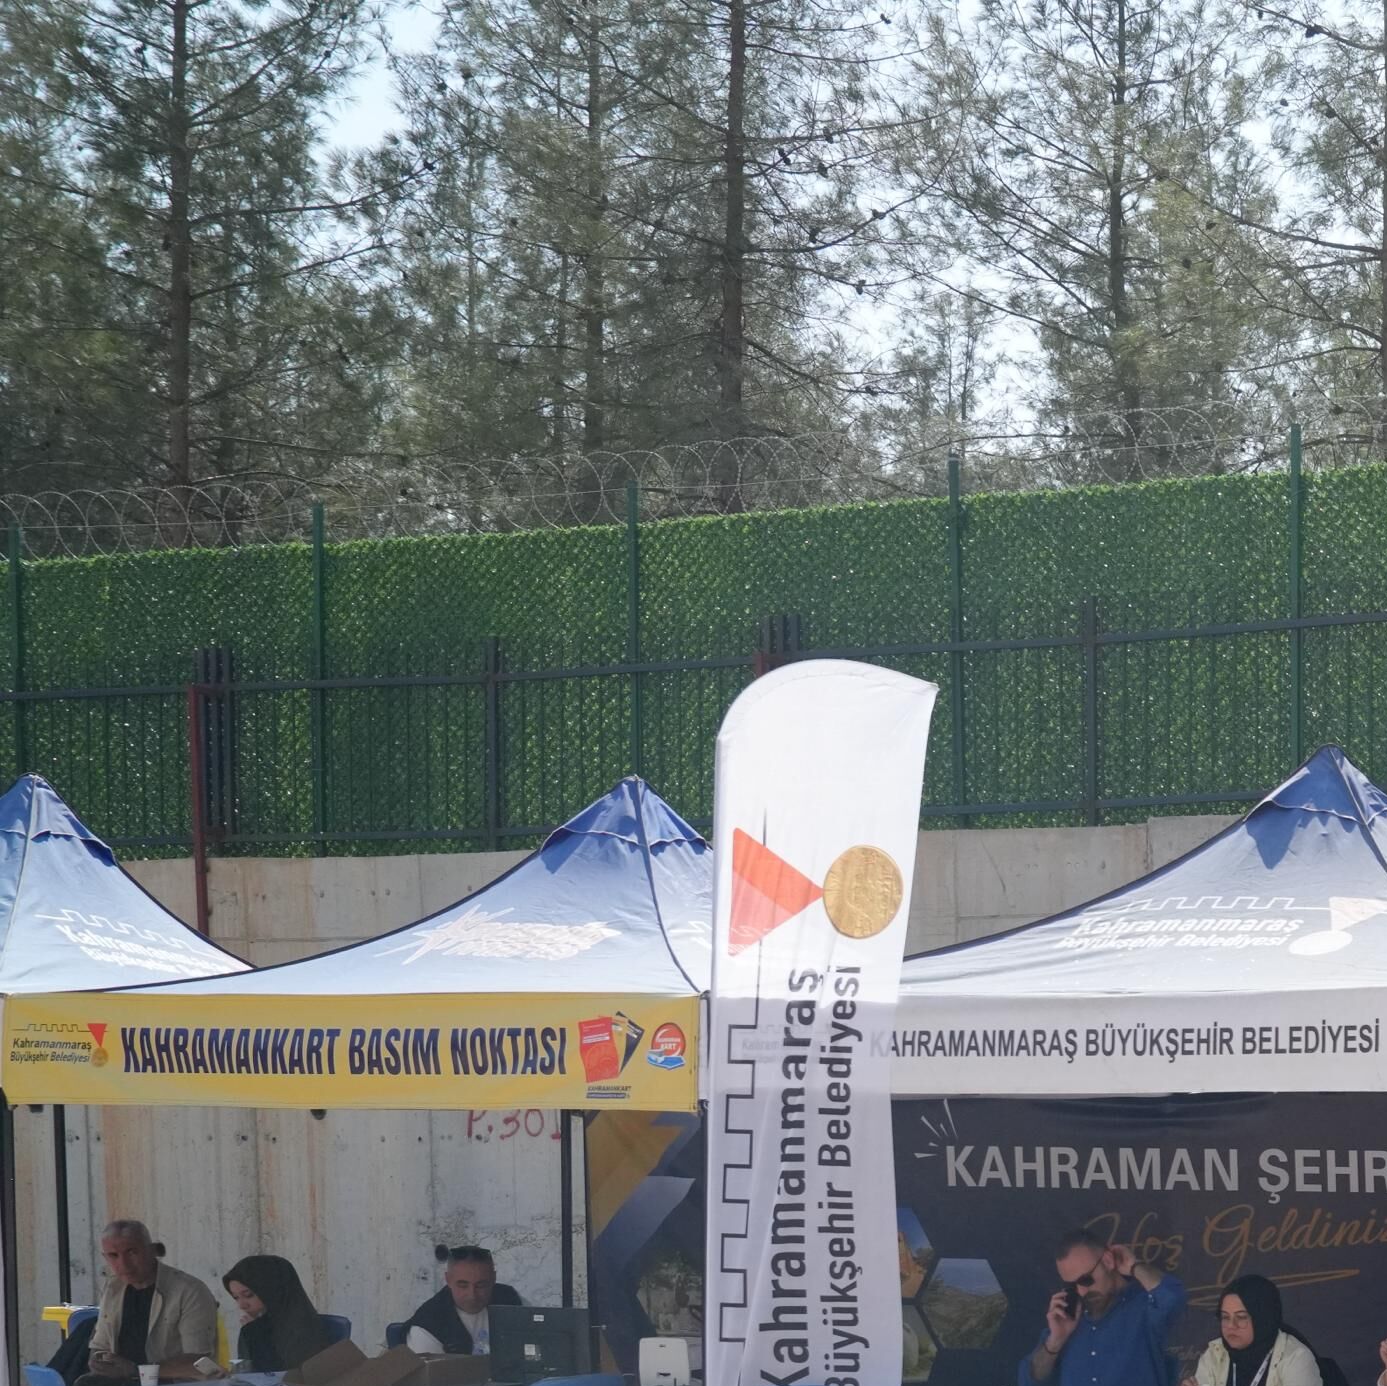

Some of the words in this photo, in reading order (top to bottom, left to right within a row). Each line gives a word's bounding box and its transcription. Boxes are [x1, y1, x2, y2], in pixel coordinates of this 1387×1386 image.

[10, 1051, 49, 1064] Büyükşehir
[50, 1052, 90, 1063] Belediyesi
[13, 1038, 92, 1050] Kahramanmaraş
[121, 1027, 341, 1075] KAHRAMANKART
[349, 1028, 442, 1075] BASIM
[451, 1027, 567, 1076] NOKTASI
[1085, 1022, 1234, 1063] BÜYÜKŞEHİR
[1242, 1018, 1379, 1054] BELEDİYESİ
[818, 965, 863, 1167] Belediyesi
[759, 967, 824, 1386] Kahramanmaraş
[945, 1145, 1239, 1192] KAHRAMAN
